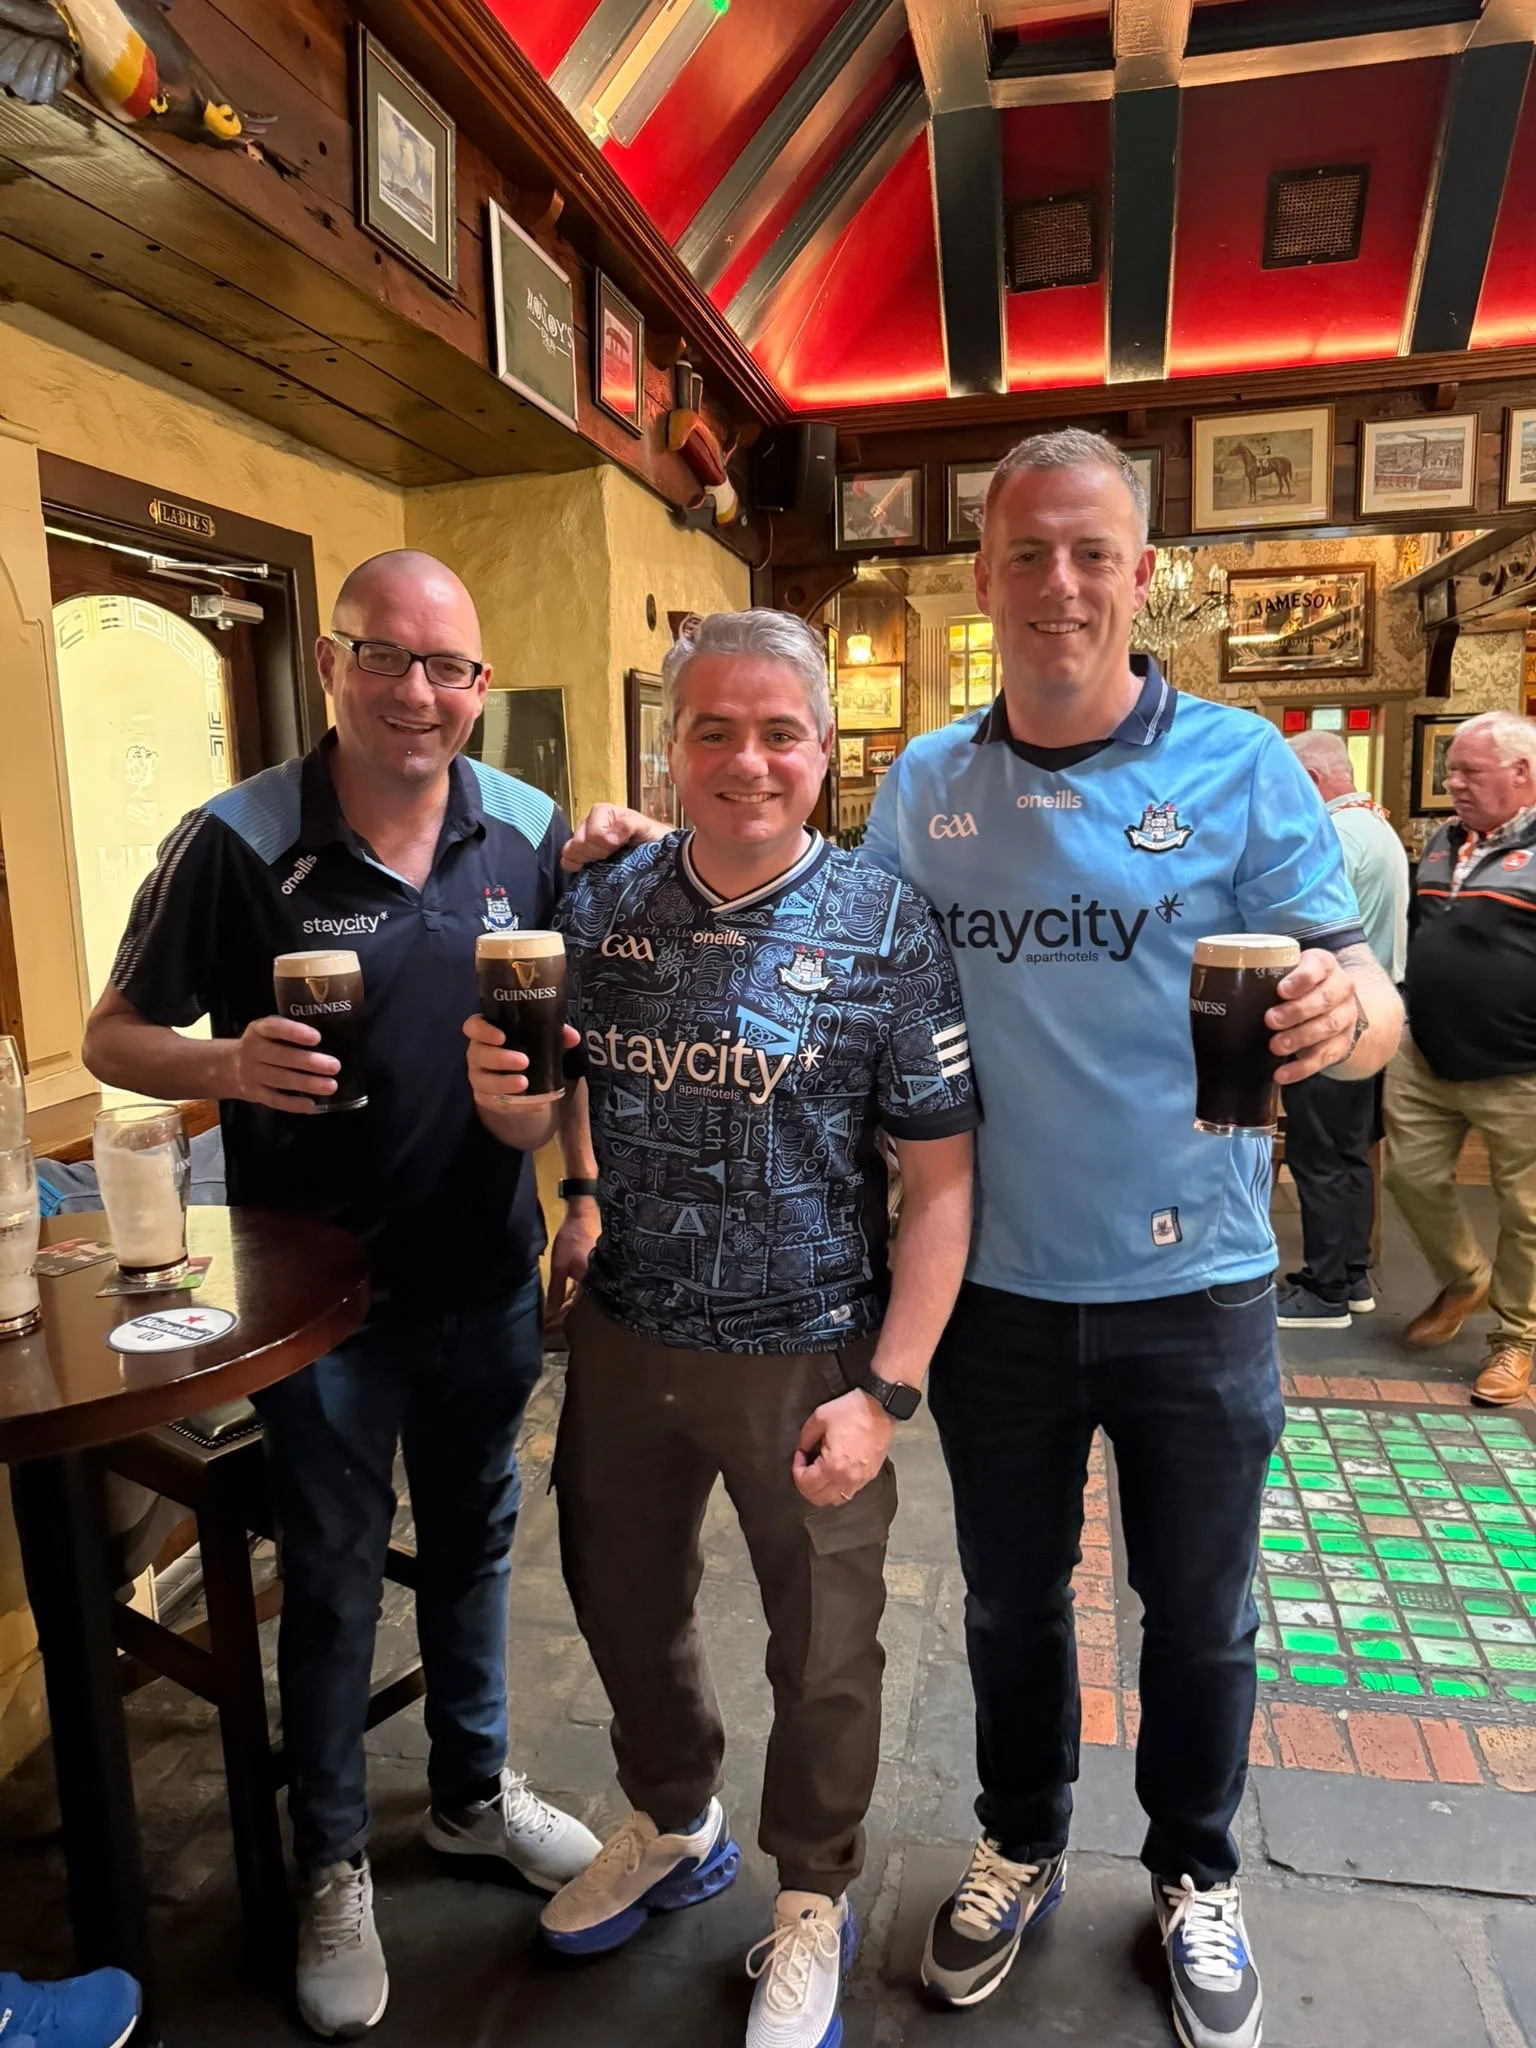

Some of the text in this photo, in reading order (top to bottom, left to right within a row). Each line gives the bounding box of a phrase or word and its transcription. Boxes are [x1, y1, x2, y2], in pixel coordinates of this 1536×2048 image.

[162, 505, 209, 532] LADIES
[1254, 592, 1339, 617] JAMESON
[928, 812, 980, 839] GAA
[302, 913, 379, 936] staycity
[601, 933, 655, 962] GAA
[1025, 950, 1099, 964] aparthotels
[492, 986, 557, 1002] GUINNESS
[289, 999, 352, 1016] GUINNESS
[1190, 998, 1227, 1016] NNESS
[585, 1023, 794, 1106] staycity
[678, 1082, 741, 1101] aparthotels
[136, 1317, 204, 1340] Heineken
